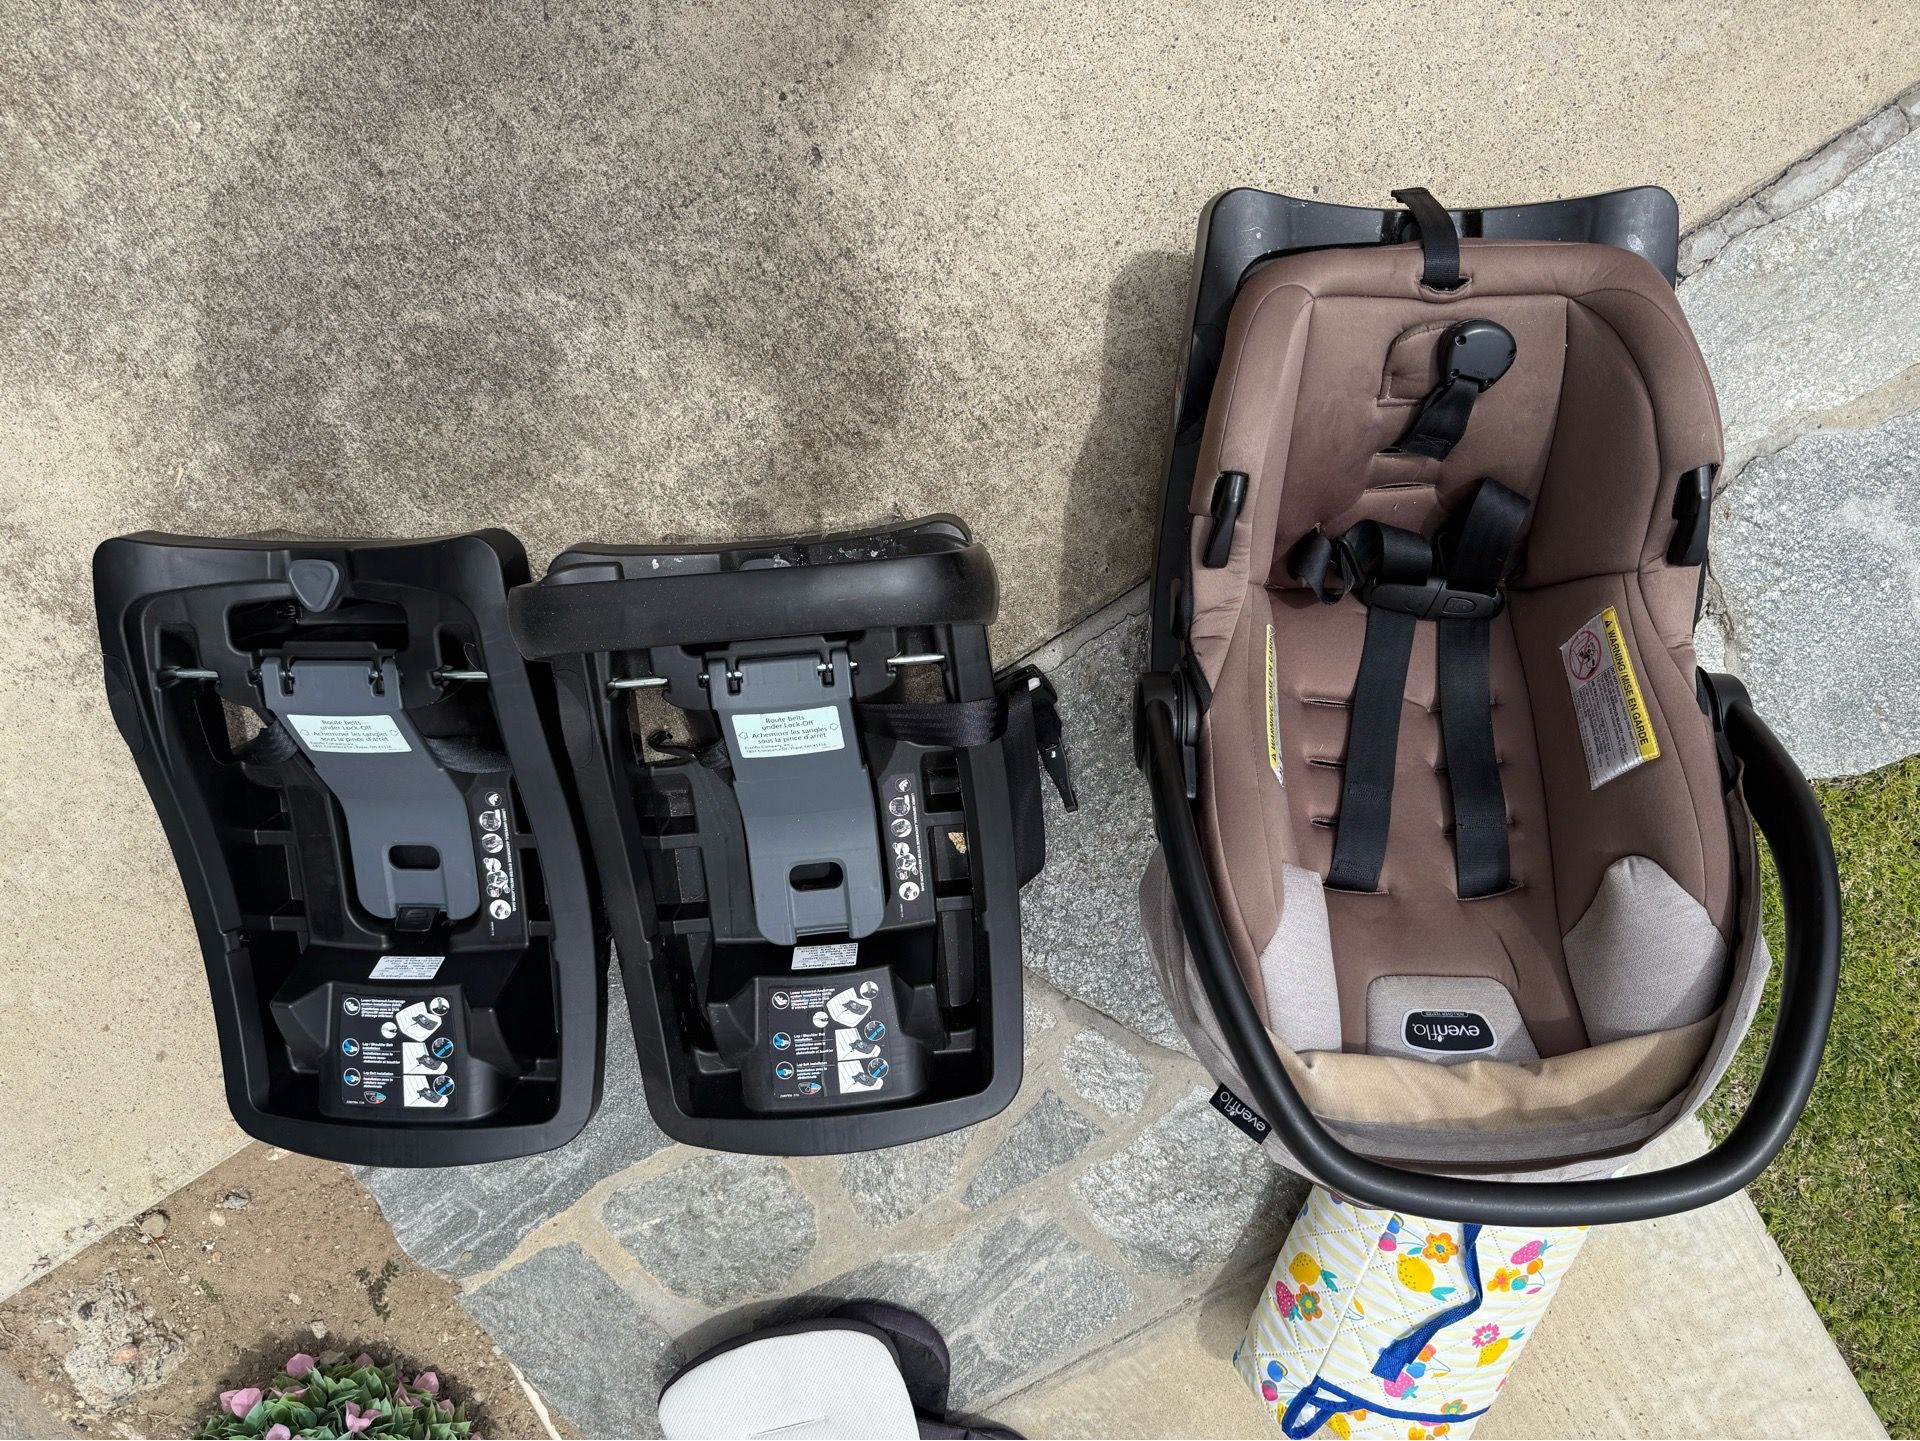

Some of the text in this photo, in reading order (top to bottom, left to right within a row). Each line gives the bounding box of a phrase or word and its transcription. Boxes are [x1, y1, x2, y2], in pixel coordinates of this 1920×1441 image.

[1628, 697, 1638, 712] EN
[783, 720, 814, 728] Lock-Off
[1632, 711, 1649, 746] GARDE
[751, 731, 789, 739] Acheminer
[1413, 1024, 1480, 1042] evenflo
[1220, 1091, 1266, 1131] evenflo
